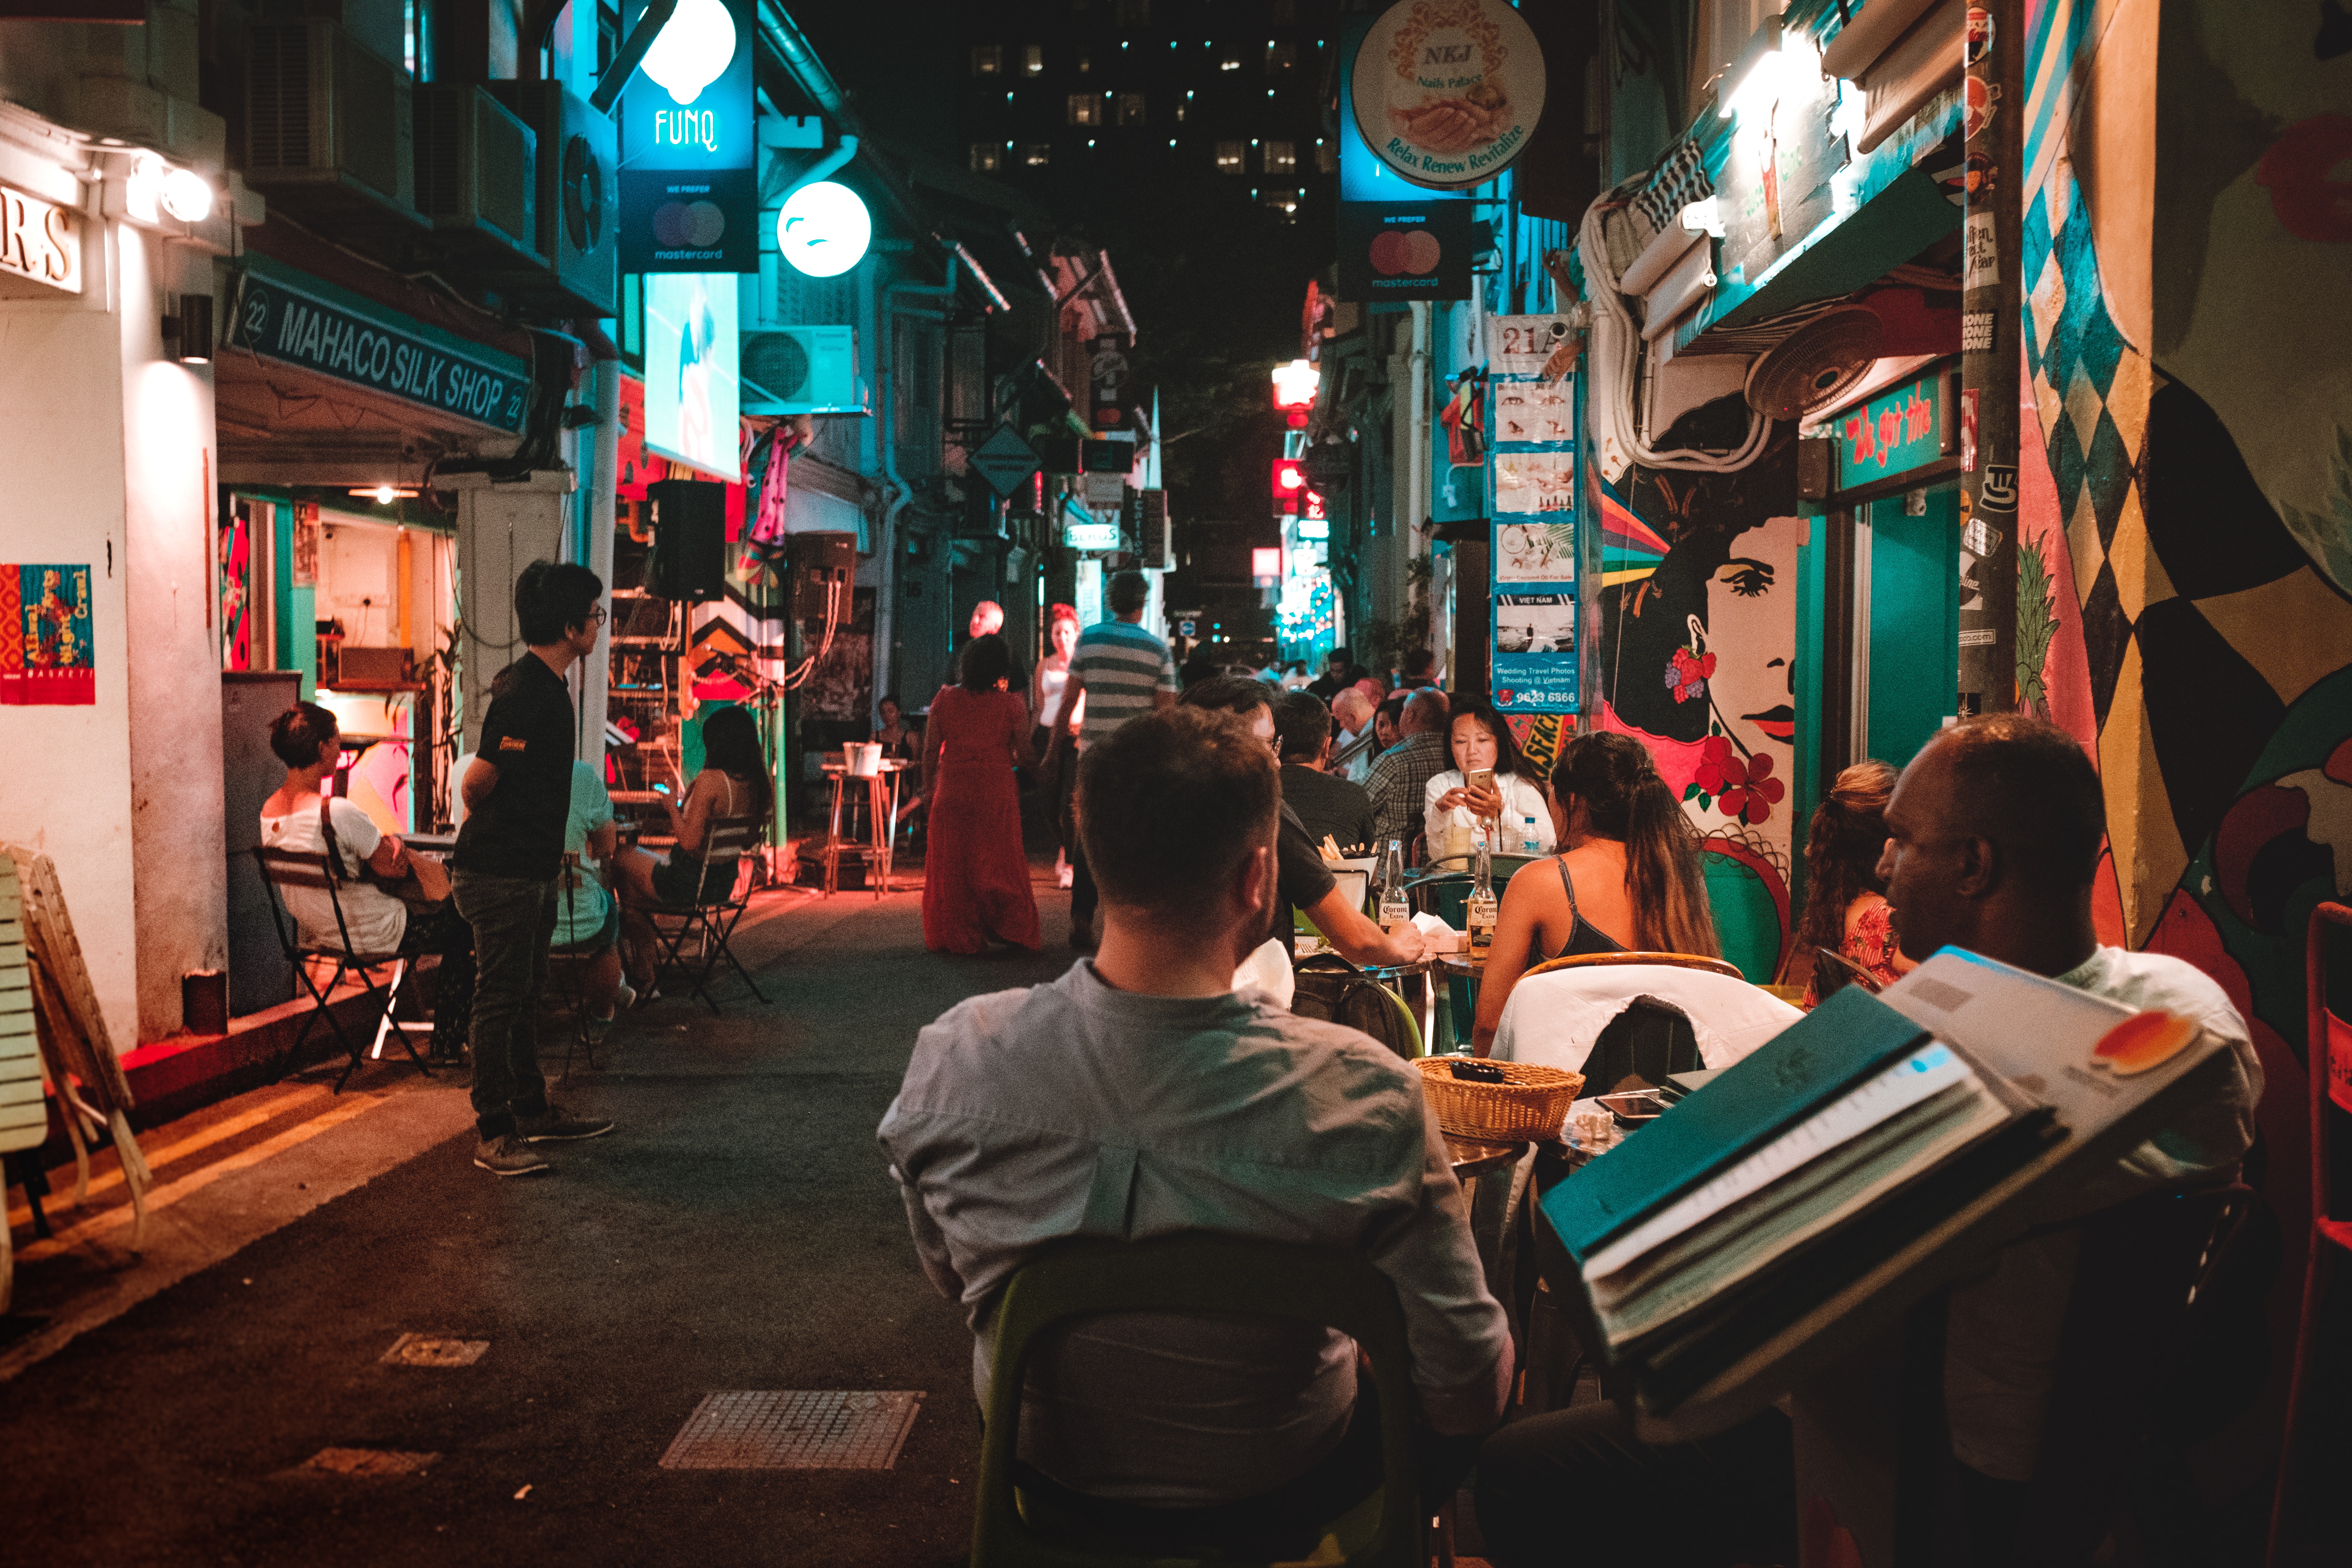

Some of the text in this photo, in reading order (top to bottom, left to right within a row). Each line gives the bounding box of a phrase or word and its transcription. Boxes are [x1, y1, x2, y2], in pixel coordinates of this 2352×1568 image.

[1425, 45, 1471, 64] NKJ
[1418, 74, 1482, 88] Nails Palace
[656, 109, 717, 152] FUNQ
[1387, 125, 1524, 173] Relax Renew Revitalize
[655, 249, 722, 259] mastercard
[1372, 277, 1438, 287] mastercard
[246, 301, 521, 418] 22 MAHACO SILK SHOP 22
[1906, 381, 1931, 445] the
[1548, 692, 1575, 702] 6866
